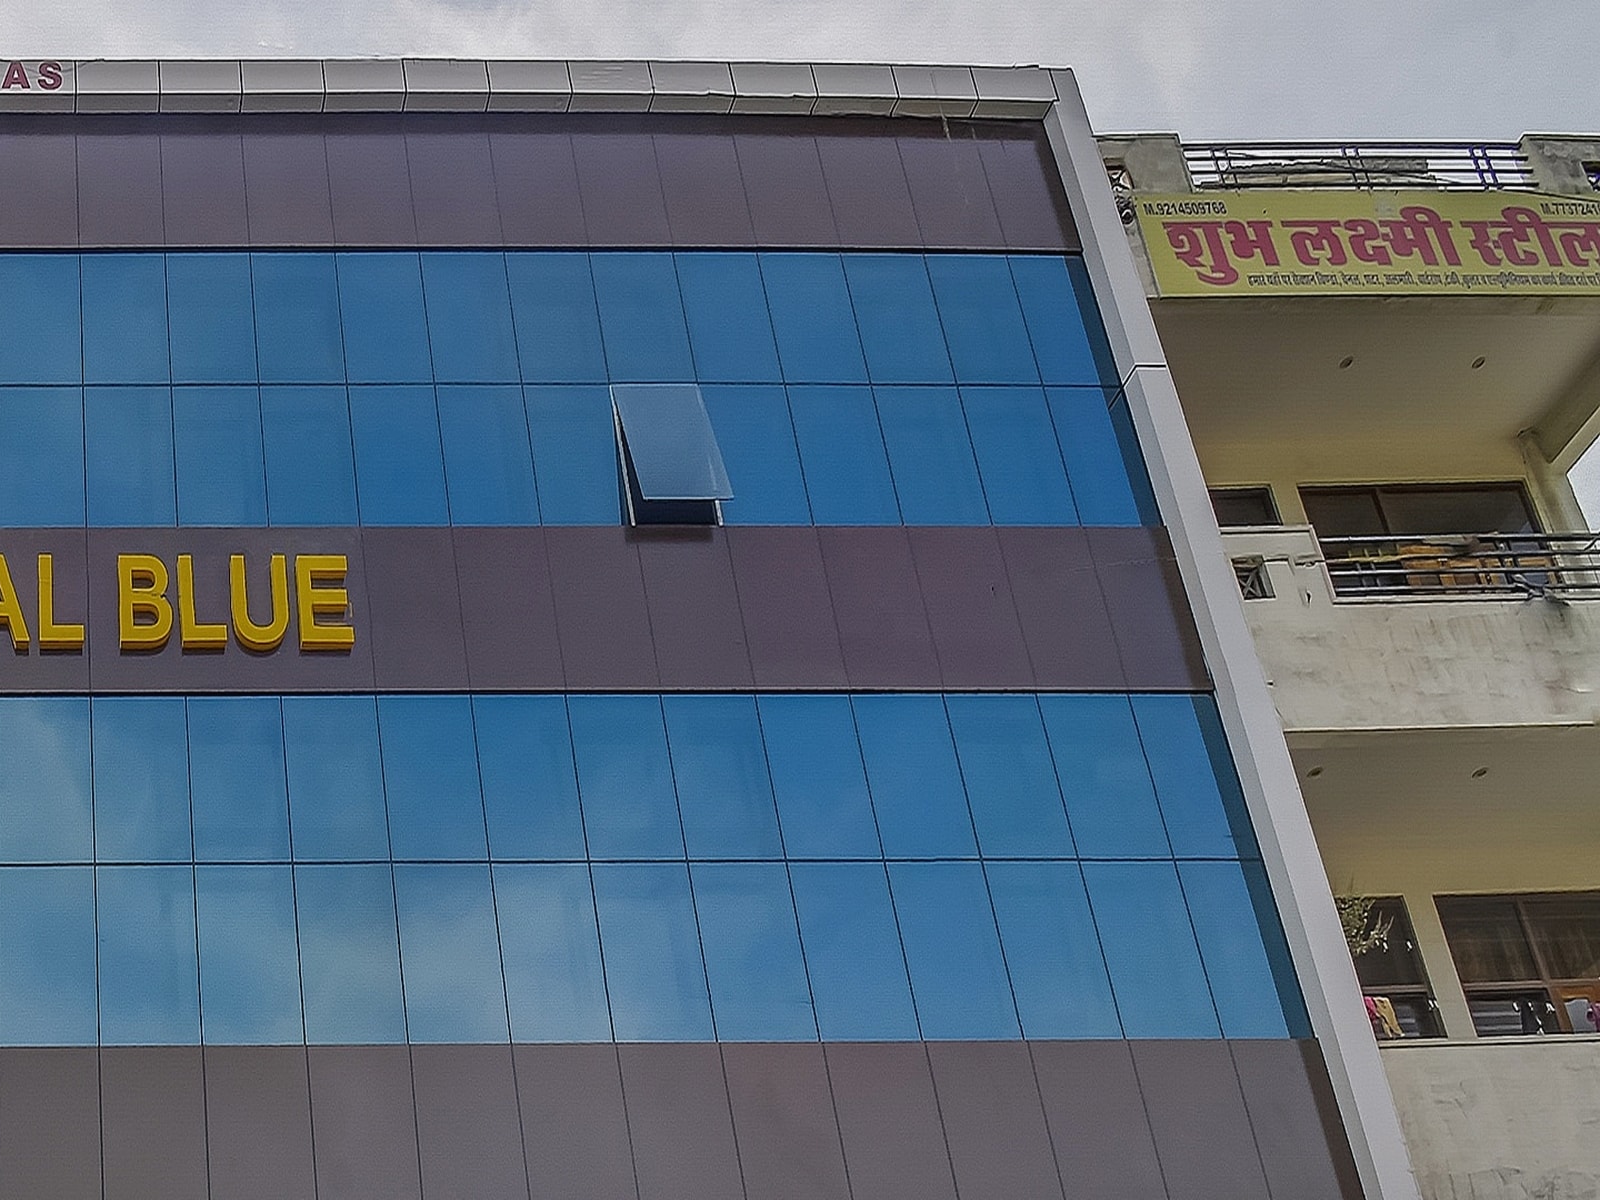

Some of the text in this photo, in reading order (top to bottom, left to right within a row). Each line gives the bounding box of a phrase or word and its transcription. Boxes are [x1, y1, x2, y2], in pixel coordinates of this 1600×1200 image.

[1162, 220, 1280, 285] शुभ
[1281, 206, 1462, 267] लक्ष्मी
[116, 553, 356, 652] BLUE
